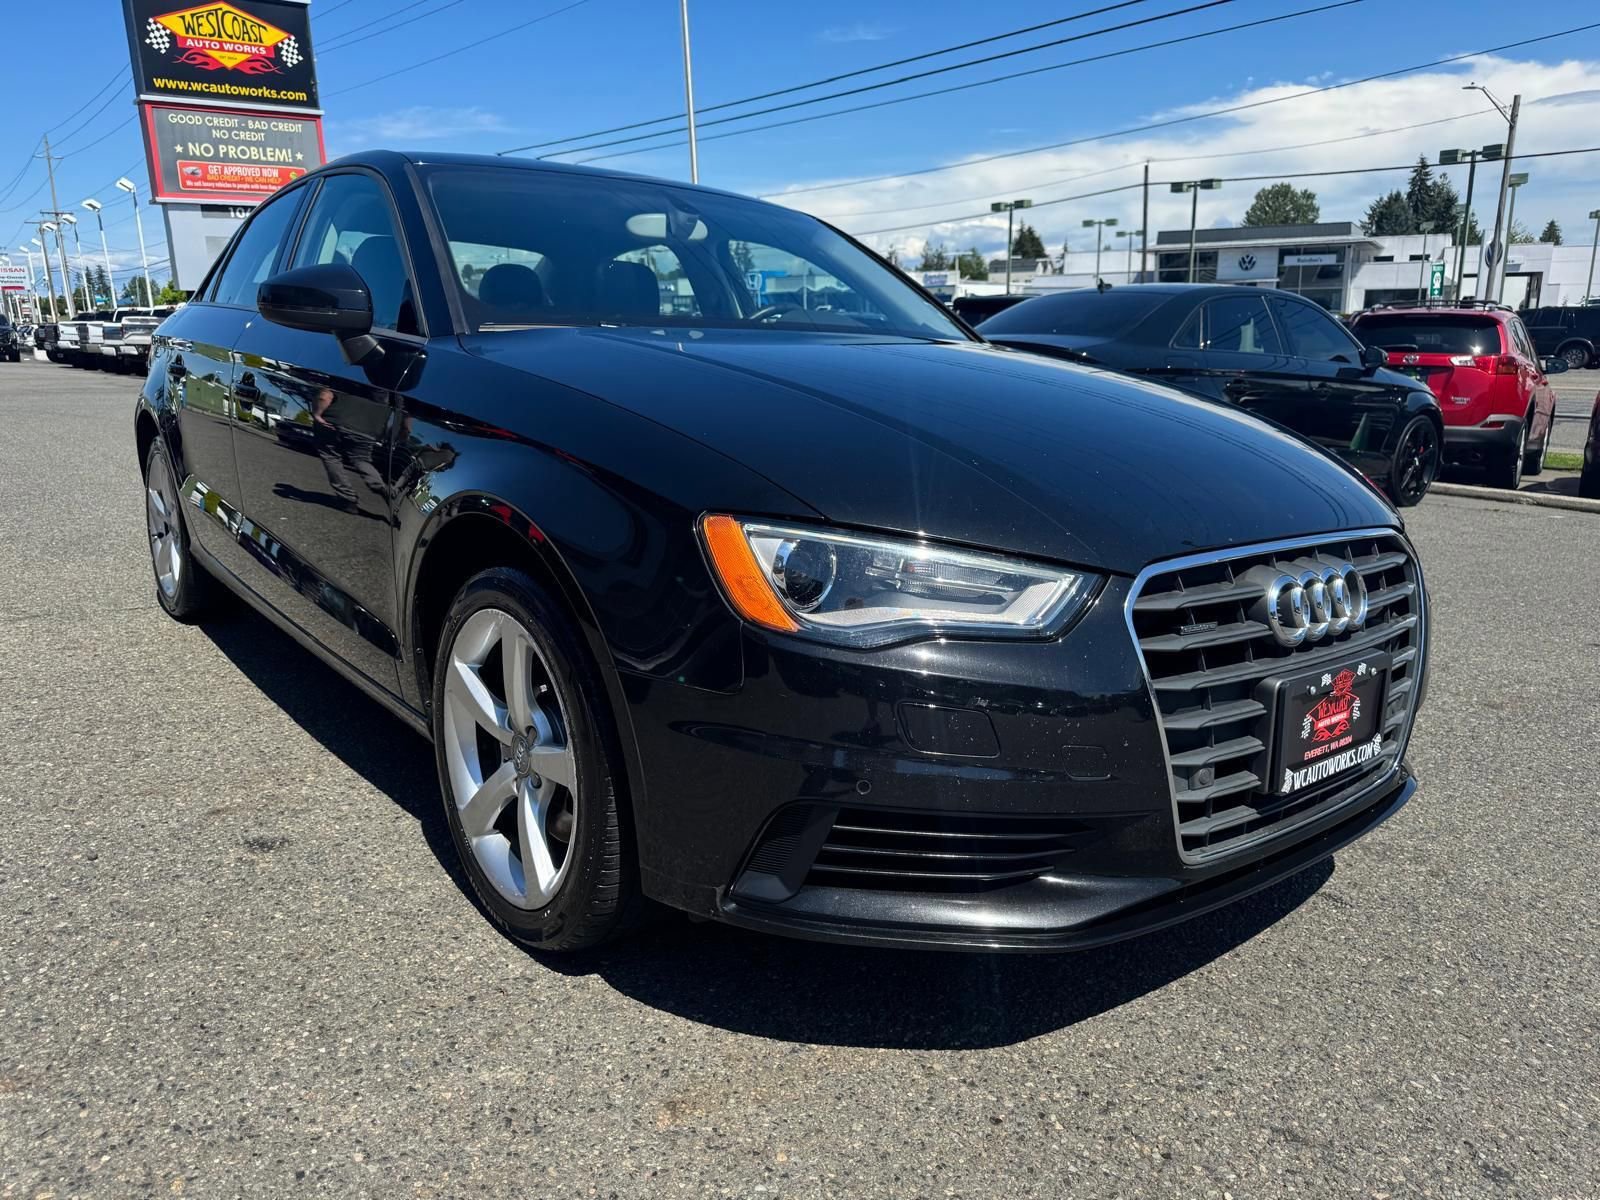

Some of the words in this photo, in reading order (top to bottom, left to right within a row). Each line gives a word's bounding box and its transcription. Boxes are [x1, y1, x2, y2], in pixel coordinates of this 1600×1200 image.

[186, 39, 220, 50] AUTO
[224, 42, 267, 55] WORKS
[153, 78, 307, 101] www.wcautoworks.com
[168, 113, 203, 125] GOOD
[205, 117, 239, 128] CREDIT
[248, 120, 268, 131] BAD
[271, 122, 303, 133] CREDIT
[212, 129, 229, 140] NO
[232, 131, 266, 142] CREDIT
[188, 142, 214, 158] NO
[219, 145, 293, 163] PROBLEM!
[208, 164, 222, 175] GET
[223, 166, 261, 178] APPROVED
[261, 168, 279, 178] NOW
[220, 175, 240, 183] CREDIT
[1293, 742, 1374, 790] WCAUTOWORKS.COM
